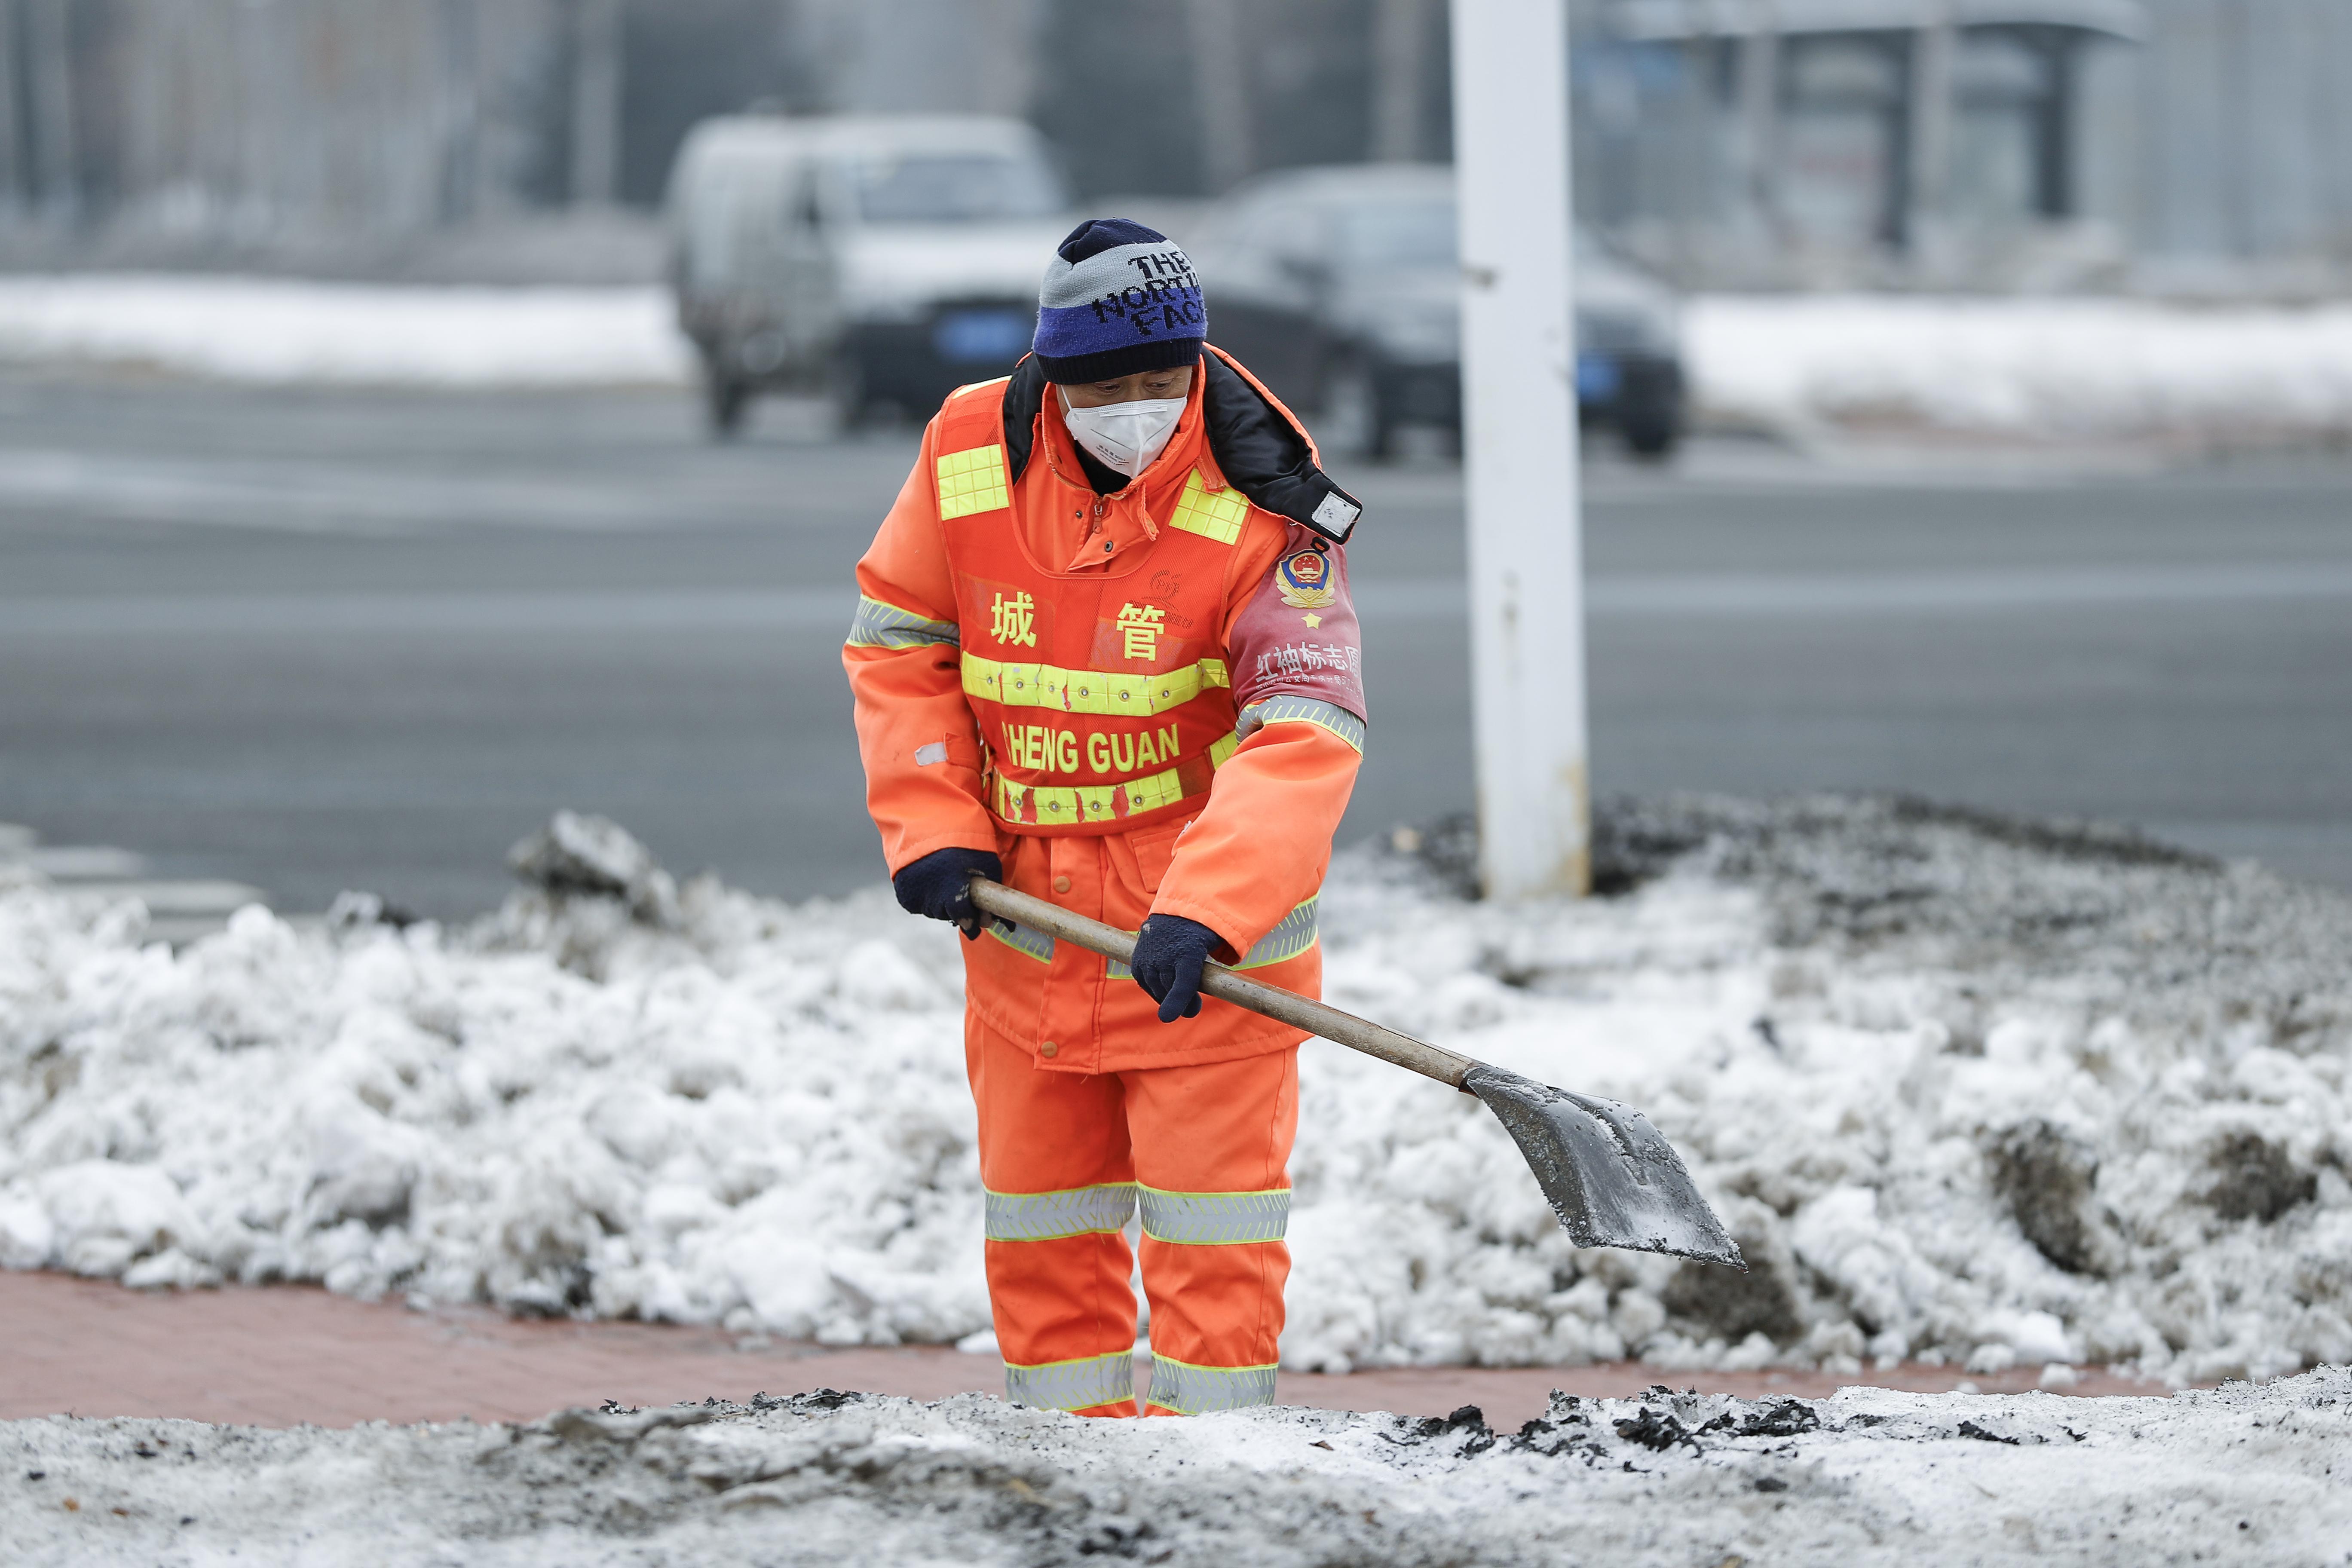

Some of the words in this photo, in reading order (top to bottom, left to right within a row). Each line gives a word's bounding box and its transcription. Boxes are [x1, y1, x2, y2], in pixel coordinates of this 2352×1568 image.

[1128, 251, 1190, 280] THE
[1091, 272, 1201, 322] NORTH
[991, 591, 1036, 648] 城
[1116, 603, 1165, 661] 管
[1001, 721, 1079, 774] HENG
[1087, 723, 1181, 773] GUAN
